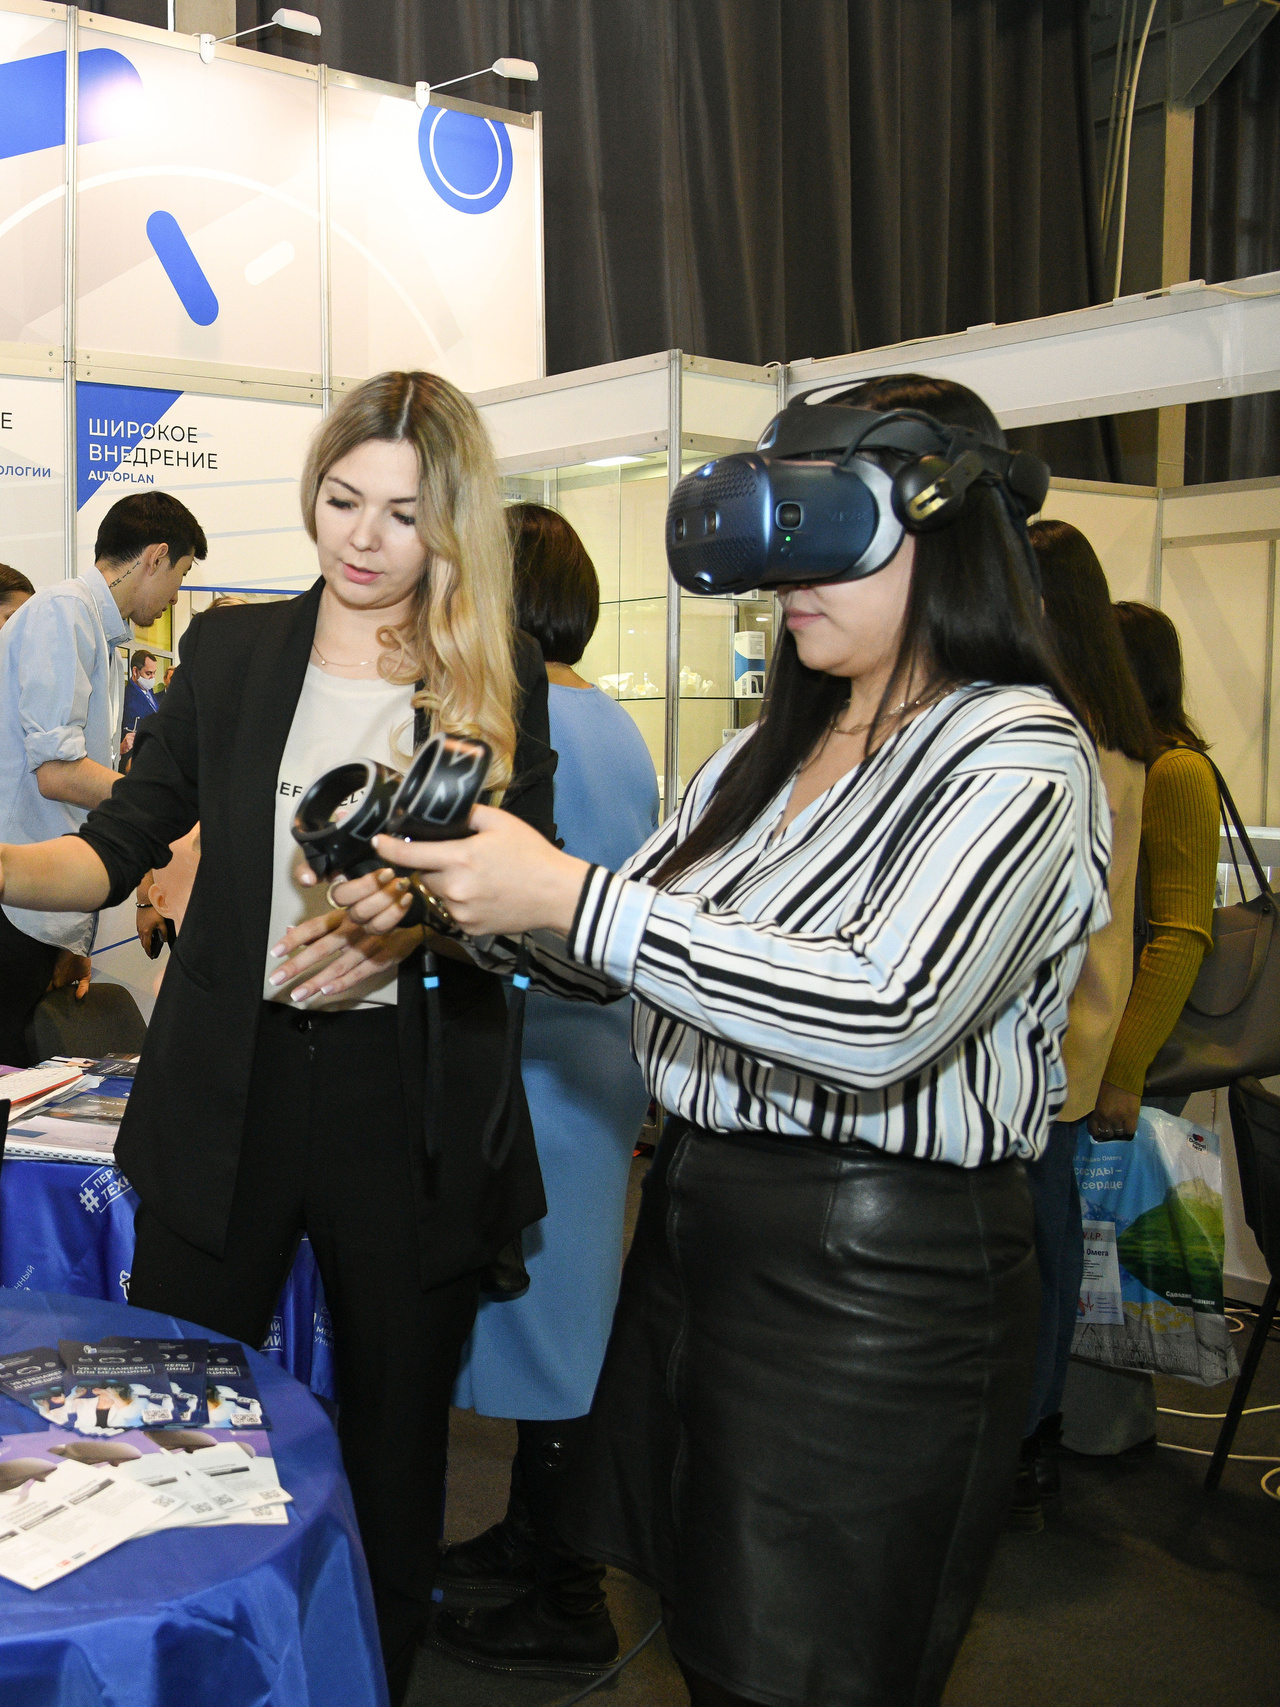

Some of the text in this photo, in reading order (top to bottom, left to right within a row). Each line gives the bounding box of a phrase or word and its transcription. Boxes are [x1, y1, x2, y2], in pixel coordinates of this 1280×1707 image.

[88, 417, 198, 444] ШИРОКОЕ
[88, 443, 218, 470] ВНЕДРЕНИЕ
[87, 470, 154, 484] AUTOPLAN
